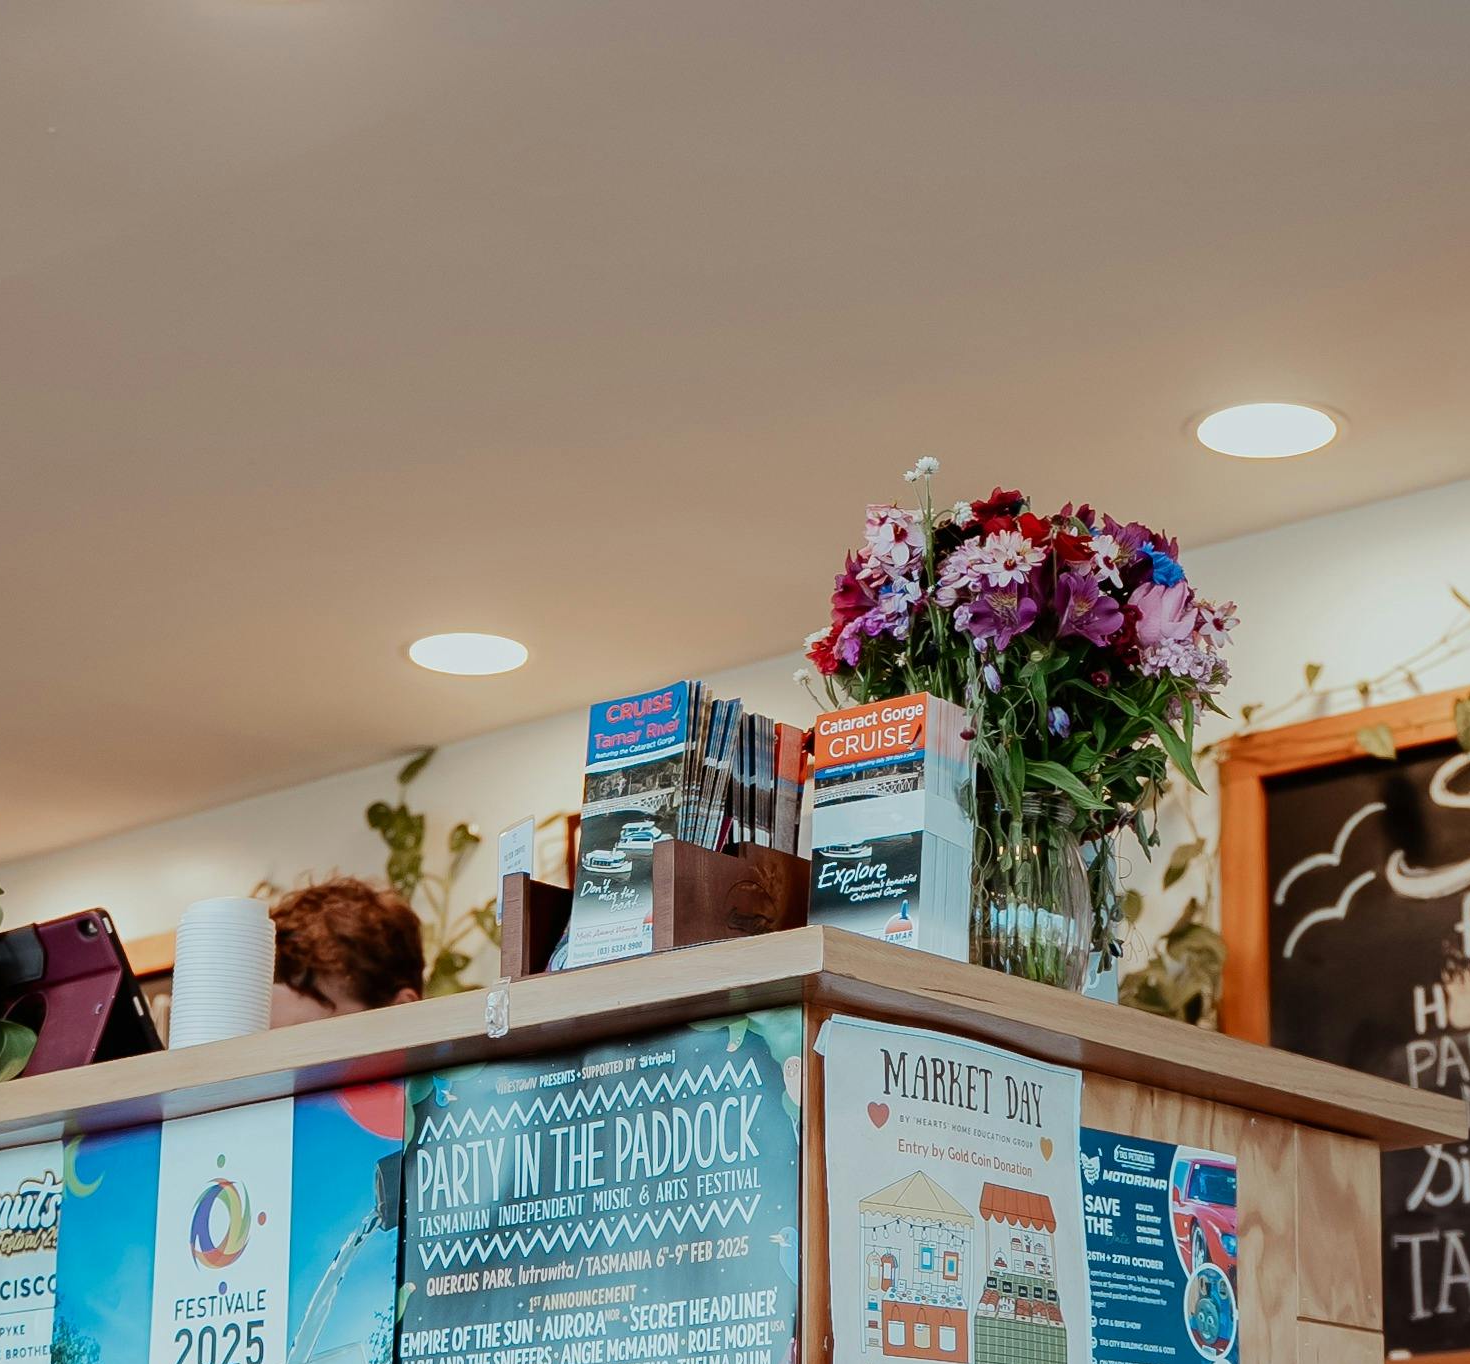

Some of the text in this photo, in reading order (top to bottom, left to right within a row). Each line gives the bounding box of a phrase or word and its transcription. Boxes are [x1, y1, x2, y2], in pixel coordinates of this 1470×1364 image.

[606, 692, 673, 723] CRUISE
[820, 704, 924, 735] Cataract Gorge
[594, 720, 680, 748] Tamar River
[629, 741, 655, 752] Cataract
[829, 724, 912, 757] CRUISE
[818, 862, 887, 893] Explore
[539, 1059, 623, 1088] PRESENTS SUPPORTED
[880, 1048, 1043, 1128] MARKET DAY
[973, 1130, 1011, 1144] EDUCATION
[417, 1094, 762, 1213] PARTY IN THE PADDOCK
[898, 1139, 1033, 1177] Entry Gold Coin Donation
[1102, 1169, 1168, 1191] MOTORAMA
[418, 1167, 761, 1237] TASMANIAN INDEPENDENT MUSIC ARTS FESTIVAL
[1085, 1194, 1121, 1217] SAVE
[1085, 1216, 1113, 1237] THE
[426, 1272, 479, 1297] QUERCUS
[482, 1267, 515, 1290] PARK,
[585, 1249, 652, 1276] TASMANIA
[716, 1236, 749, 1259] 2025
[1132, 1256, 1164, 1270] OCTOBER
[175, 1289, 266, 1320] FESTIVALE
[542, 1284, 637, 1311] ANNOUNCEMENT
[0, 1325, 25, 1337] PYKE
[400, 1319, 534, 1358] EMPIRE THE SUN
